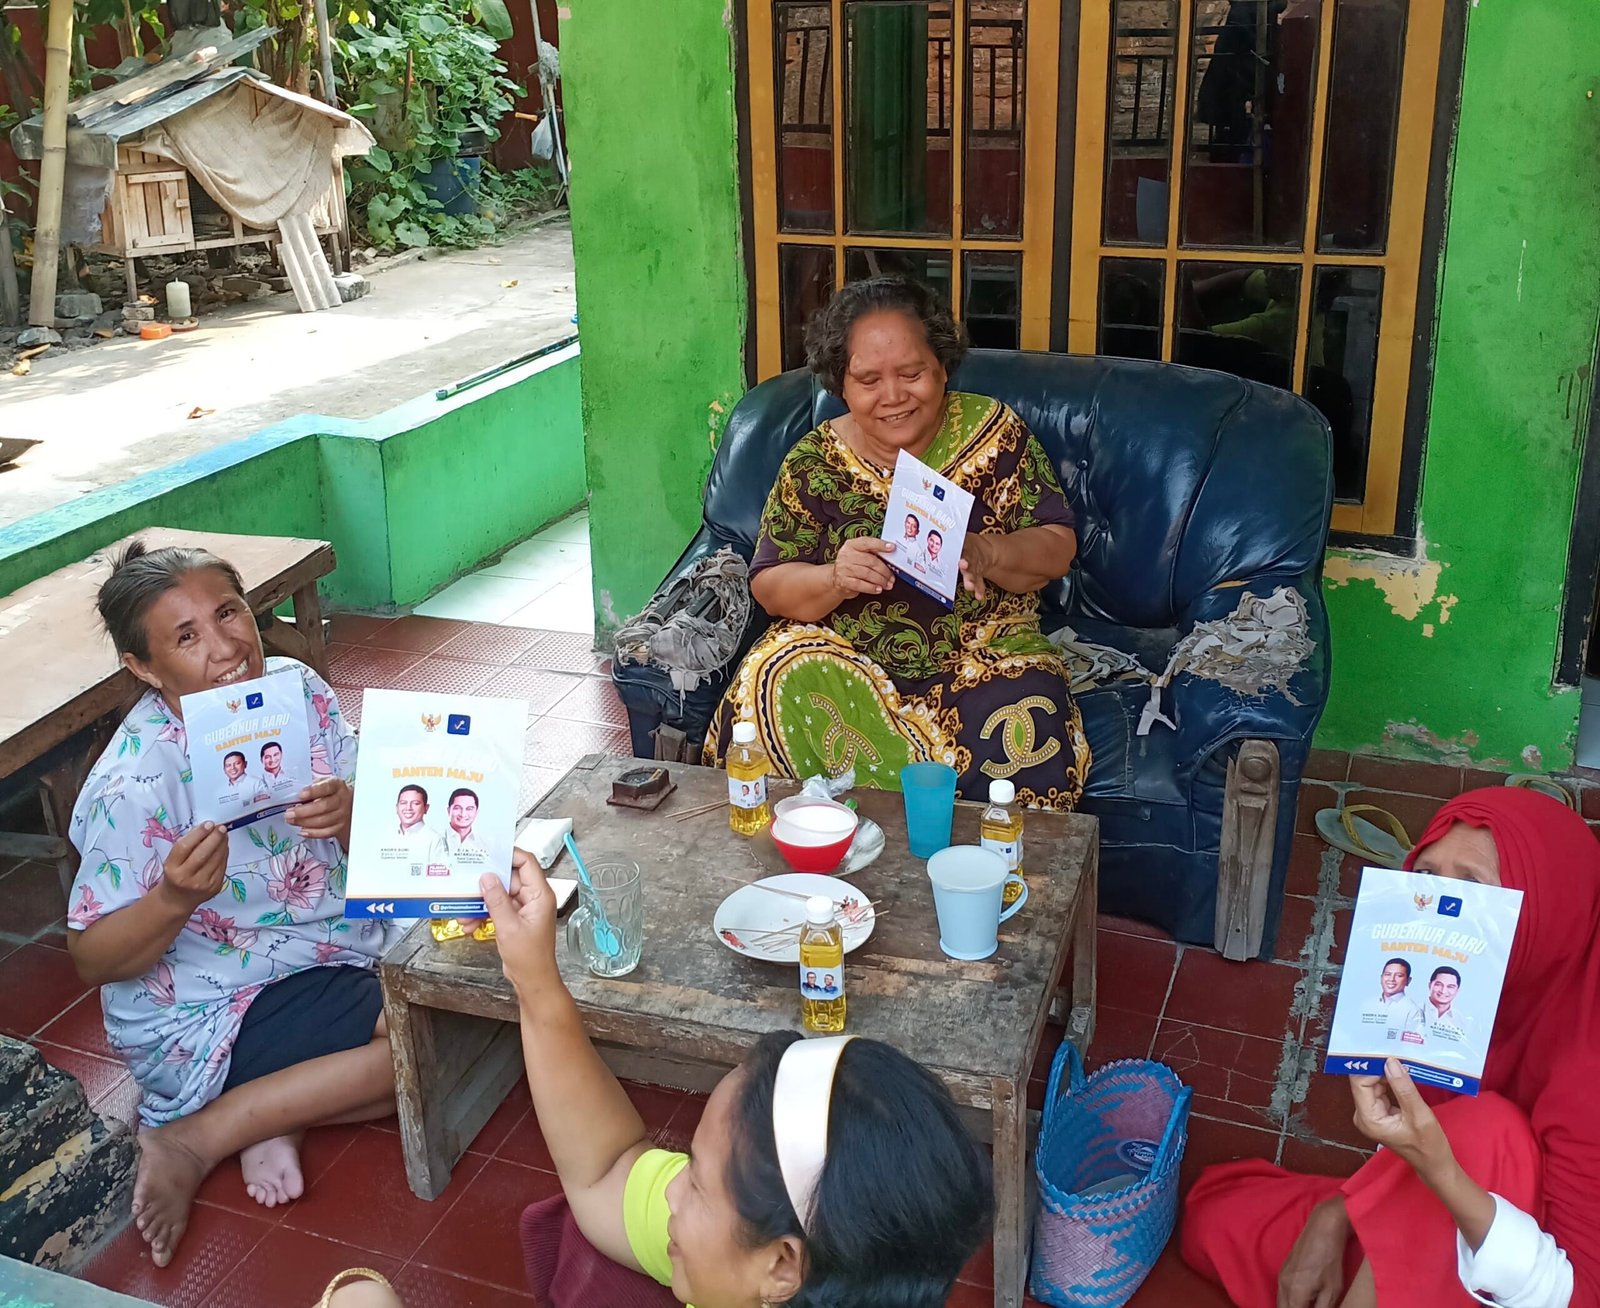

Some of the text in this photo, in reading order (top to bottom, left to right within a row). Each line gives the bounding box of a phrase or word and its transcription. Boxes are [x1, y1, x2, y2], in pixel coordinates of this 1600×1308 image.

[204, 713, 290, 745] GUBERNUR BARU
[215, 728, 282, 752] BANTEN MAJU
[392, 766, 484, 783] BANTEN MAJU
[1371, 923, 1488, 955] GUBERNUR BARU
[1381, 942, 1469, 964] BANTEN MAJU
